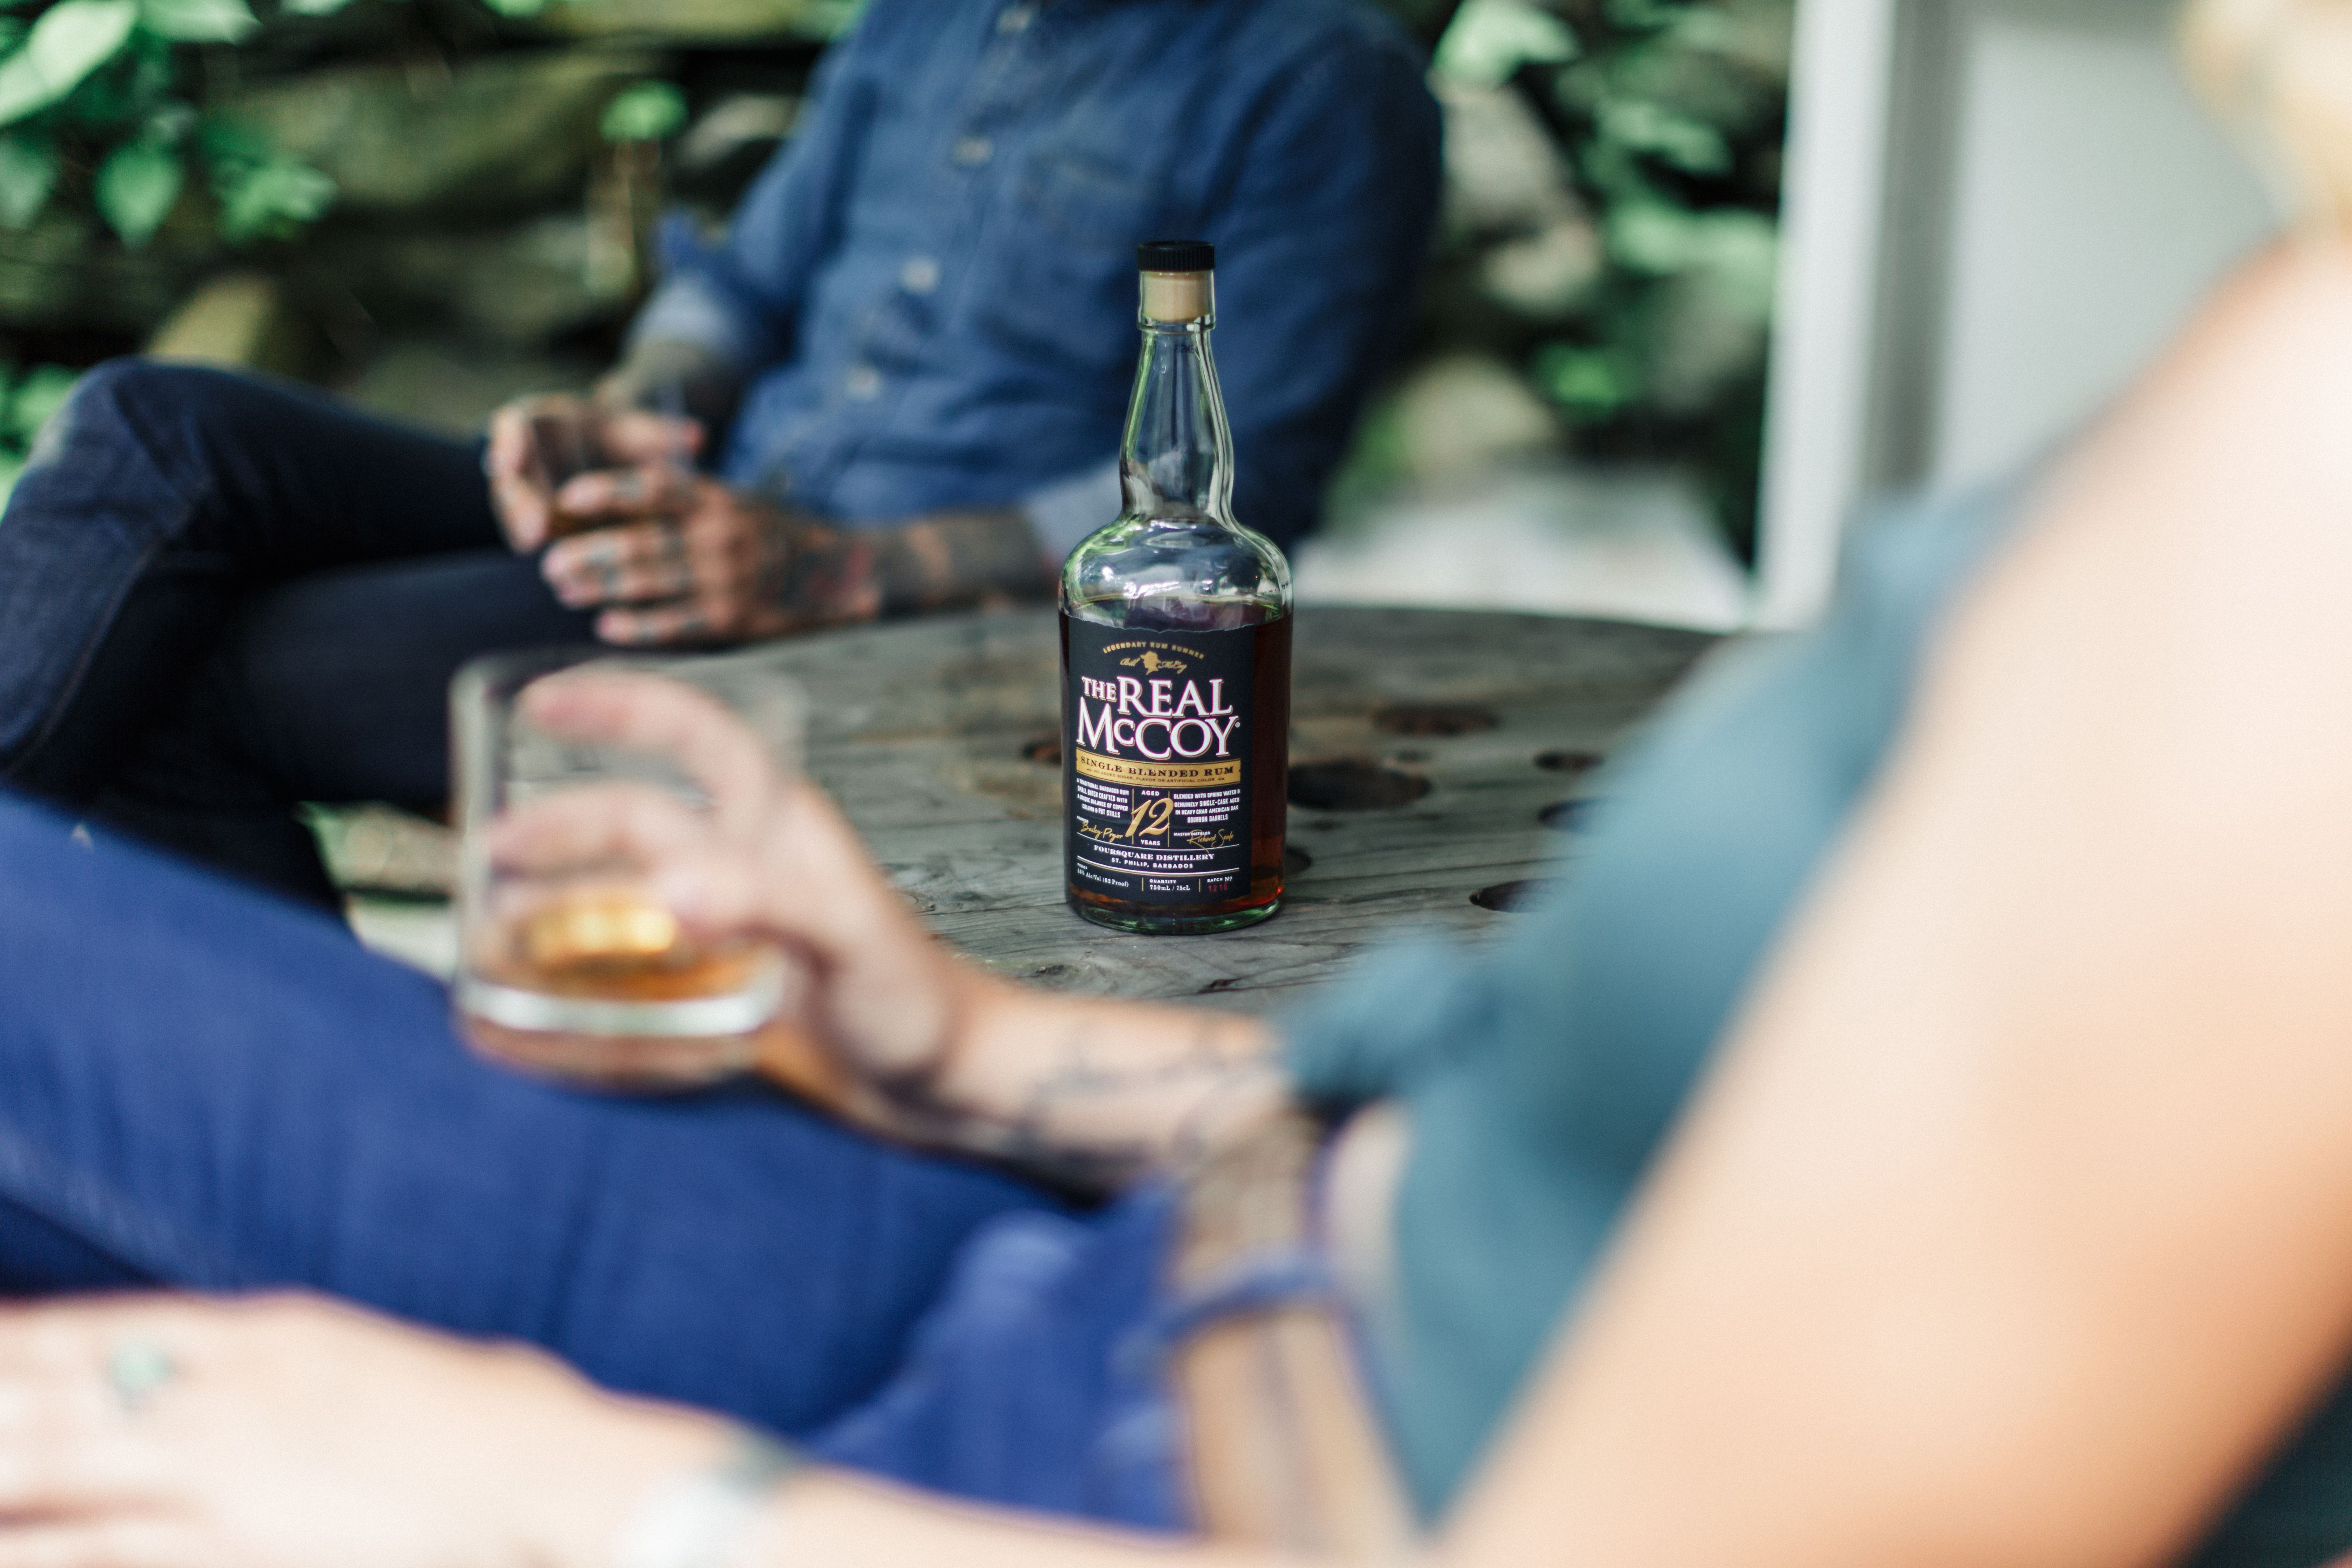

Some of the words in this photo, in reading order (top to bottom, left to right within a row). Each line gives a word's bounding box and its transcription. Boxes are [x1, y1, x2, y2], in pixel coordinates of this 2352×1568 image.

[1103, 641, 1146, 653] LEGENDARY
[1172, 644, 1204, 659] RUNNER
[1081, 676, 1117, 702] THE
[1116, 676, 1233, 718] REAL
[1081, 756, 1122, 772] SINGLE
[1129, 767, 1198, 777] BLENDED
[1204, 766, 1234, 776] RUM
[1078, 785, 1087, 794] SMALL
[1088, 789, 1098, 797] BATCH
[1099, 793, 1116, 802] CRAFTED
[1079, 778, 1098, 790] TRADITIONAL
[1099, 785, 1119, 794] BARBADOS
[1091, 798, 1106, 807] BALANCE
[1199, 798, 1228, 807] SINGLE-CASK
[1082, 804, 1095, 812] COLUMN
[1107, 810, 1120, 818] STILLS
[1125, 797, 1174, 837] 12
[1102, 828, 1123, 843] Pryor
[1094, 844, 1154, 860] FOURSQUARE
[1124, 860, 1149, 868] PHILIP,
[1086, 872, 1101, 881] Alc/Vol
[1112, 879, 1129, 887] Proof)
